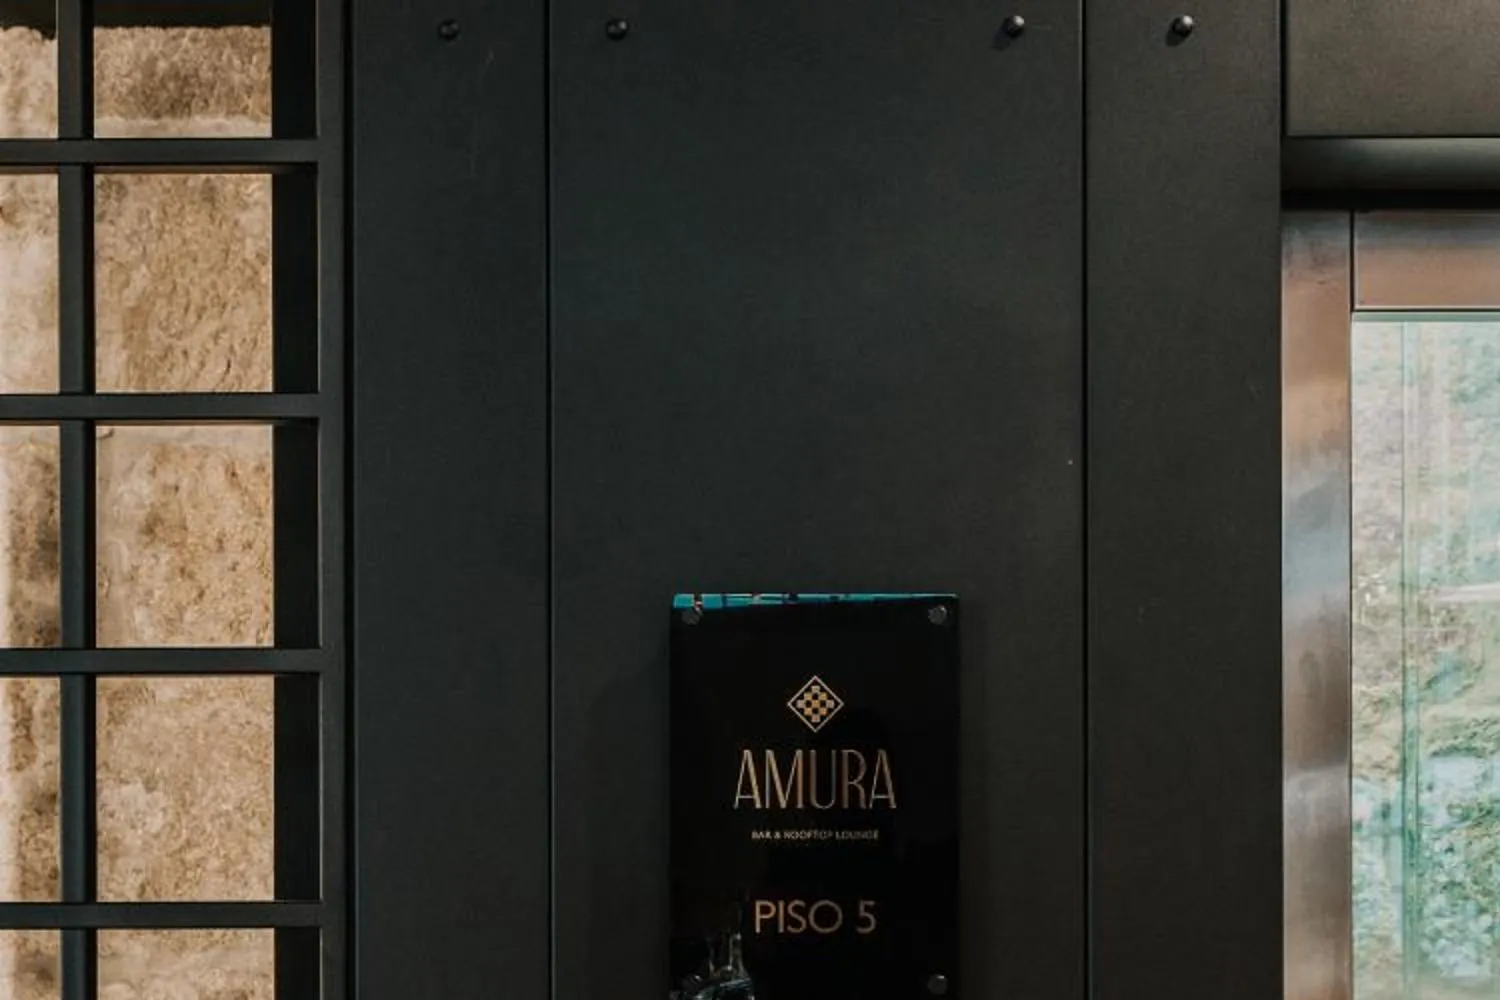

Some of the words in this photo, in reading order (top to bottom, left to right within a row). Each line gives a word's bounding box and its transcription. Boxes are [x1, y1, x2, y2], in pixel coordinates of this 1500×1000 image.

[733, 749, 897, 810] AMURA
[751, 829, 773, 841] BAR
[773, 829, 782, 841] &
[835, 829, 879, 841] LOUNGE
[755, 900, 843, 934] PISO
[857, 900, 876, 934] 5
